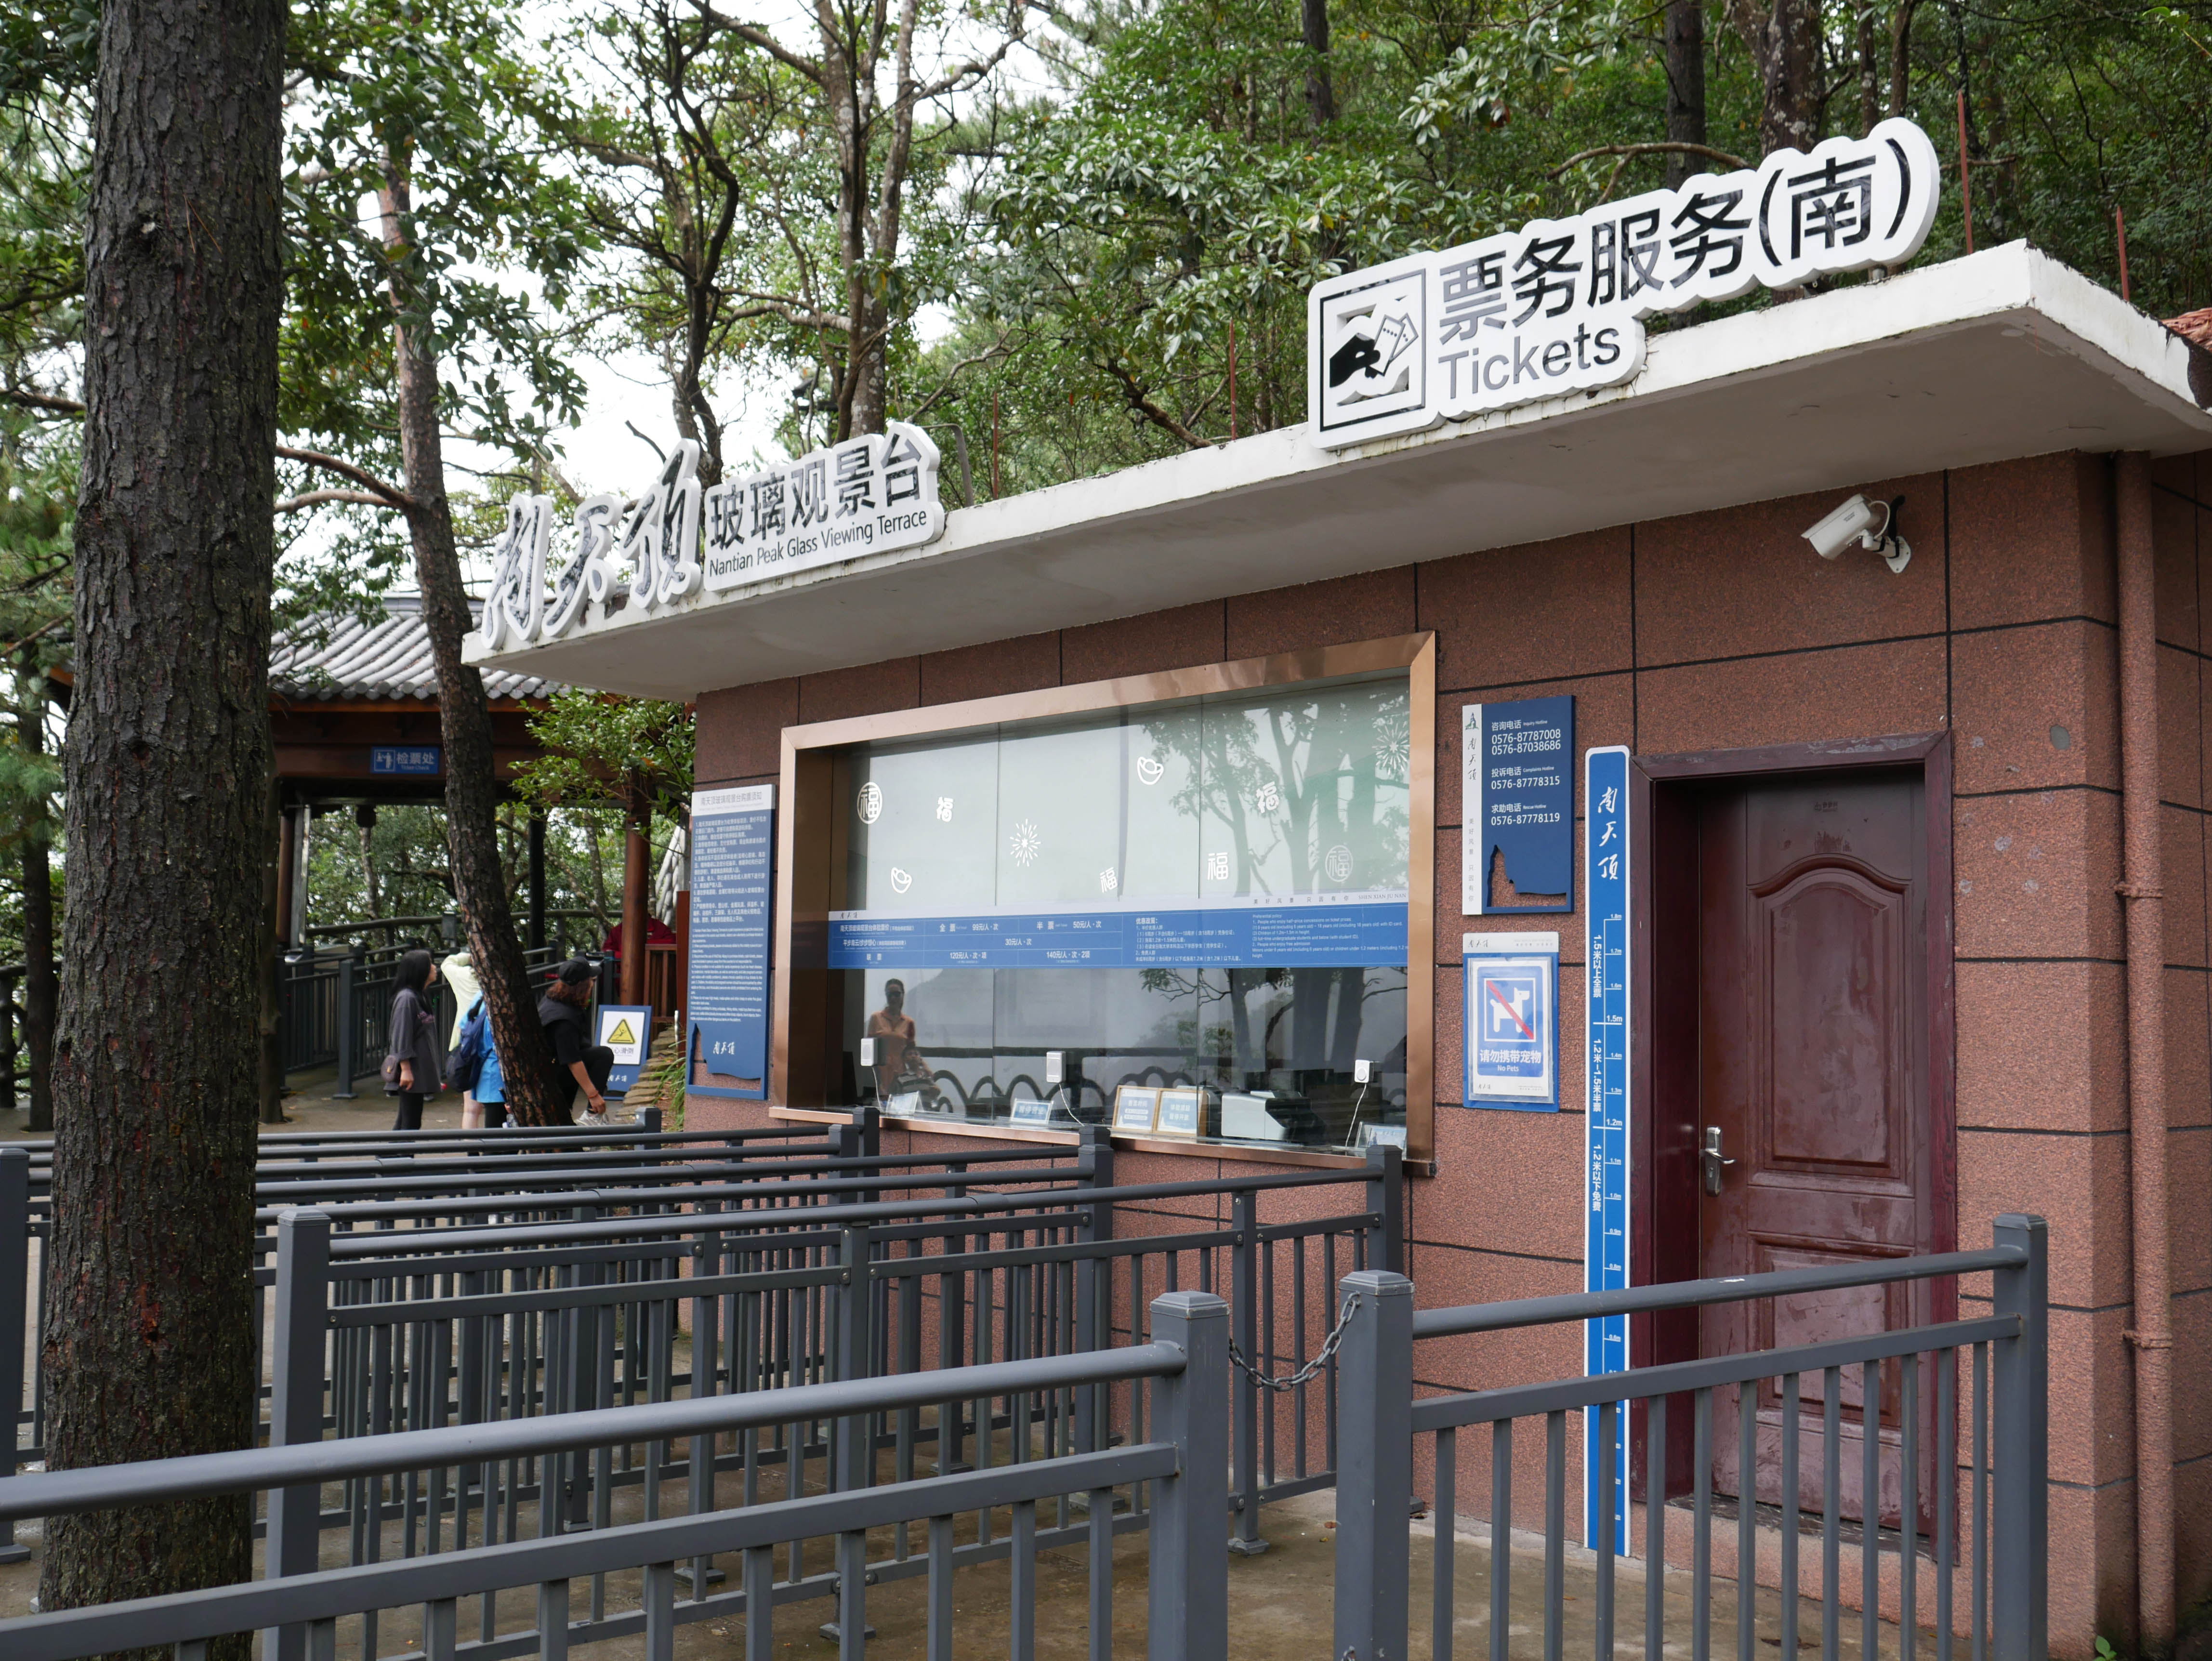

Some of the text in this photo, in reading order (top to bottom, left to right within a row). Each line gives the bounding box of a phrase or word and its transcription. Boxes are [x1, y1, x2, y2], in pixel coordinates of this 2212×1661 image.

[1439, 137, 1911, 348] 票务服务(南)
[1438, 323, 1621, 398] Tickets
[709, 433, 921, 551] 玻璃观景台
[709, 510, 927, 578] Nantian Peak Glass Viewing Terrace
[1491, 720, 1522, 731] 咨询电话
[1492, 728, 1561, 744] 0576-87787008
[397, 752, 434, 765] 检票处
[1492, 739, 1561, 755] 0576-87038686
[1491, 766, 1522, 778] 投诉电话
[1491, 775, 1560, 790] 0576-87778315
[861, 788, 880, 819] 福
[1491, 803, 1522, 814] 求助电话
[1491, 812, 1560, 826] 0576-87778119
[1207, 852, 1229, 881] 福
[1330, 850, 1350, 878] 福
[1100, 867, 1118, 894] 福
[1593, 935, 1602, 998] 1.5米以上全票
[1480, 1049, 1541, 1064] 请勿携带宠物
[1593, 1039, 1602, 1112] 1.2米-1.5米半票
[1593, 1145, 1602, 1212] 1.2米以下免费
